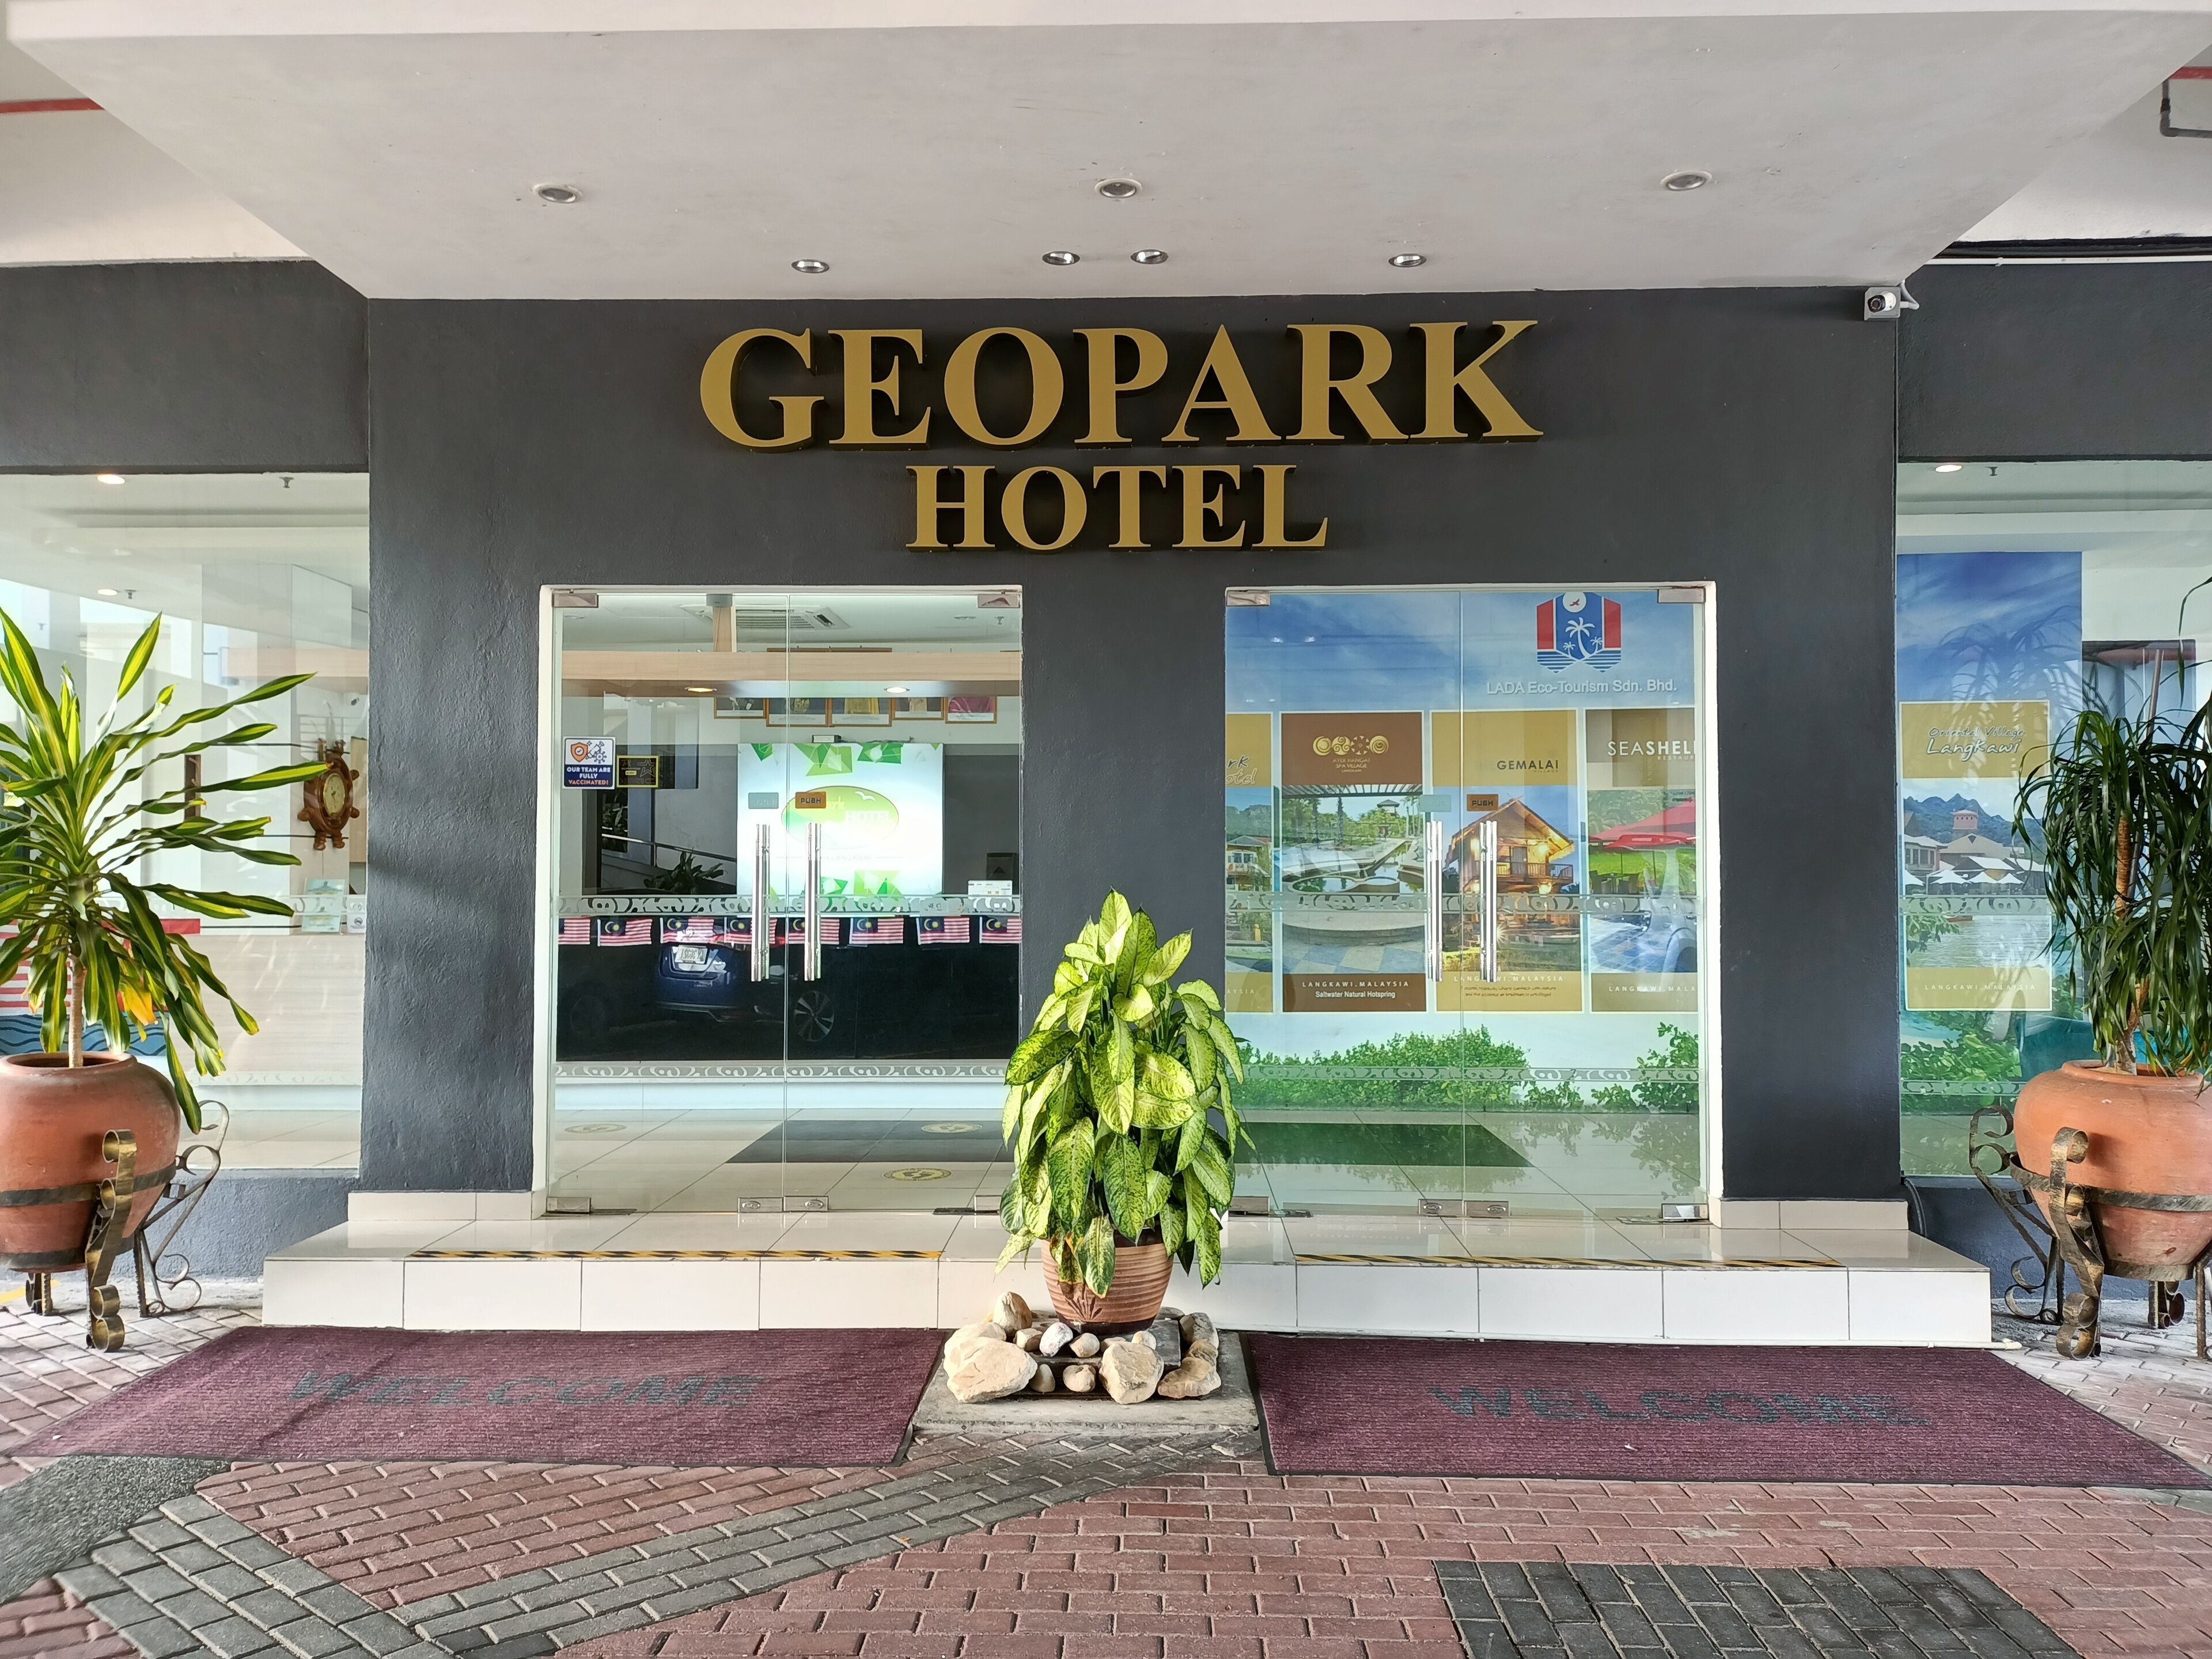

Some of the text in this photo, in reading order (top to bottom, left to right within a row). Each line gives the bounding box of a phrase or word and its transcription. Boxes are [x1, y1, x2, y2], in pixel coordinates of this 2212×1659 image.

[699, 319, 1545, 452] GEOPARK
[906, 464, 1329, 552] HOTEL
[1486, 679, 1677, 695] LADA Eco-Tourism Sdn. Bhd.
[1929, 726, 2025, 740] Oriental Village
[1497, 759, 1559, 771] GEMALAI
[1367, 991, 1396, 999] Hotspring
[288, 1371, 764, 1407] WELCOME
[1429, 1386, 1933, 1426] WELCOME
